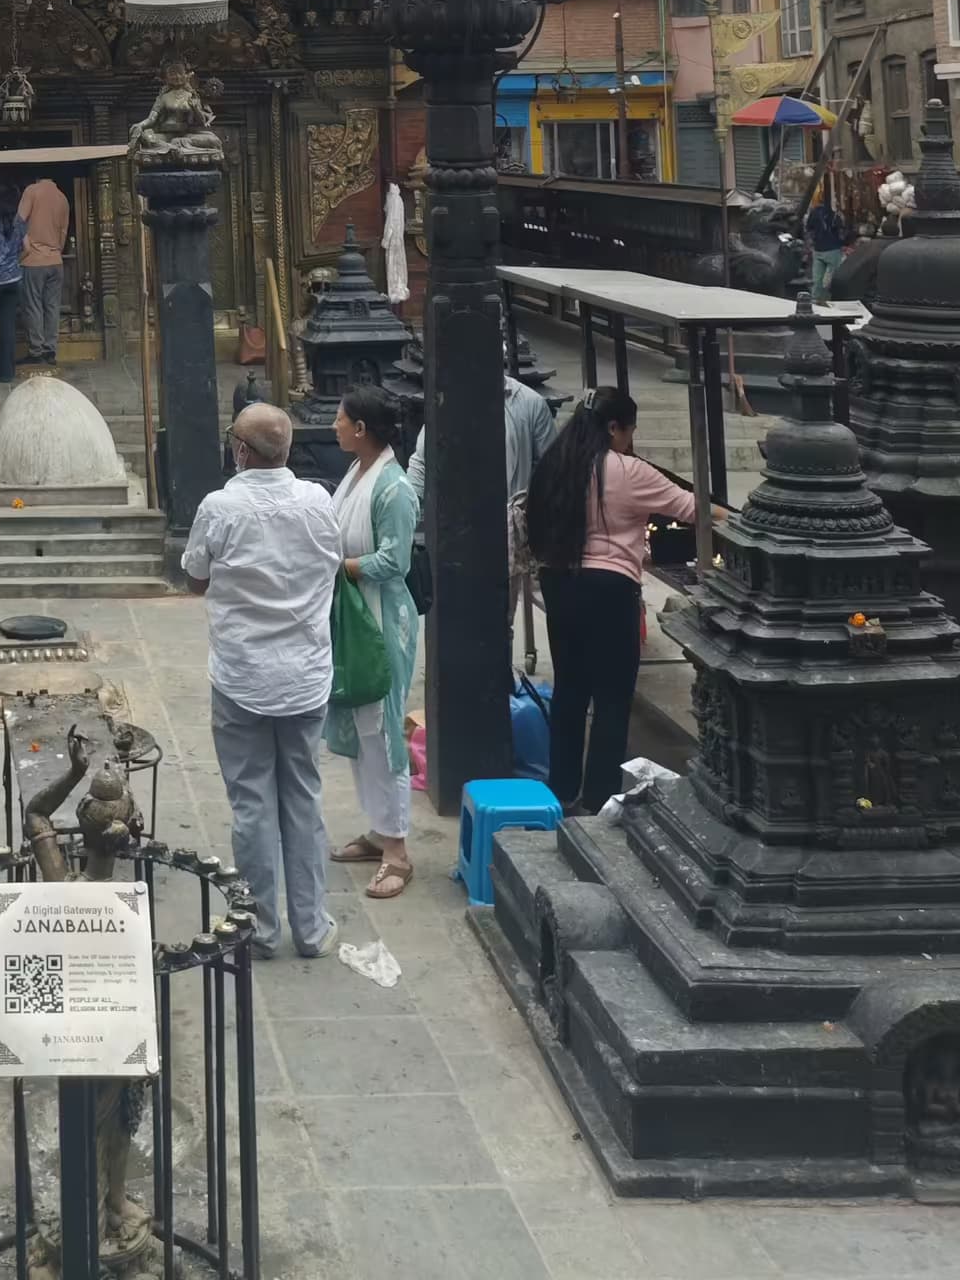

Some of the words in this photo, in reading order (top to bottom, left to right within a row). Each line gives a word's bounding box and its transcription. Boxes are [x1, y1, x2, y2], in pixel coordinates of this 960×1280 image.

[24, 905, 30, 915] A
[32, 904, 61, 917] Digital
[64, 905, 102, 917] Gateway
[105, 905, 114, 915] to
